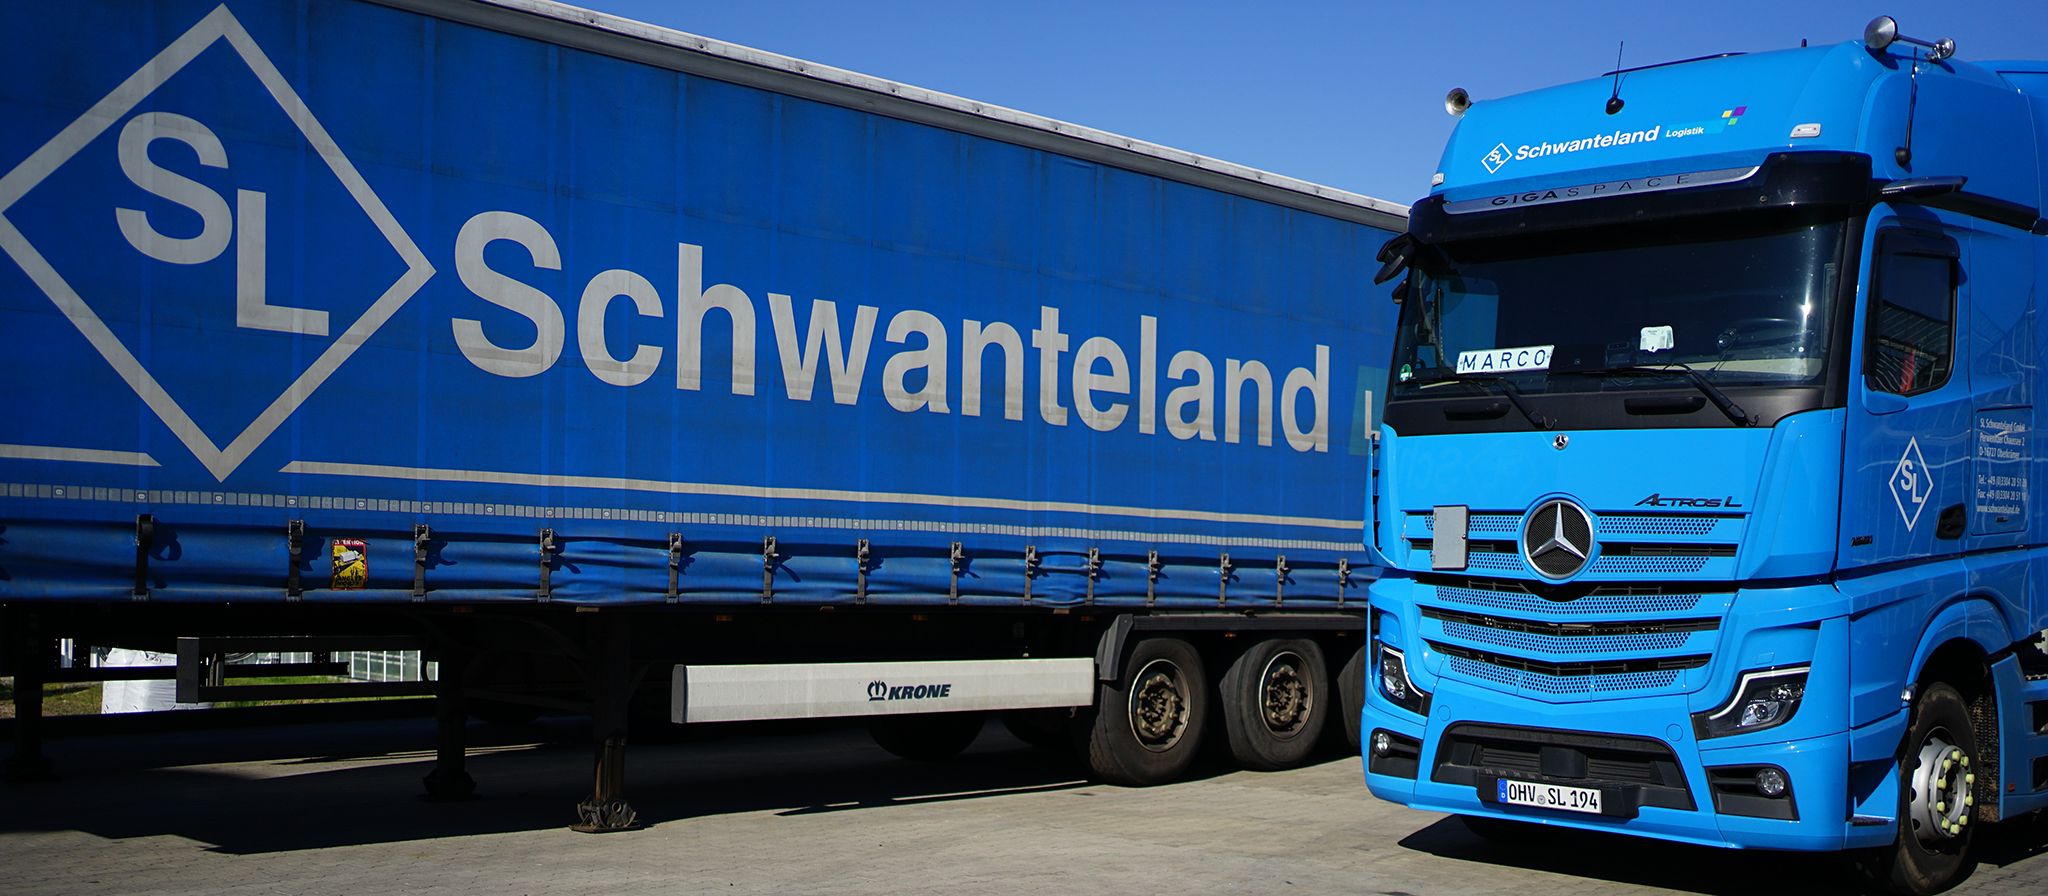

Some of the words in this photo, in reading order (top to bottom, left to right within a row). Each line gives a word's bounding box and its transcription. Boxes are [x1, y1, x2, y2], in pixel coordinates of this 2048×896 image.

[1515, 125, 1660, 161] Schwanteland
[1665, 126, 1704, 138] Logistik
[115, 111, 330, 336] SL
[451, 210, 1330, 453] Schwanteland
[1463, 350, 1546, 371] MARCO
[1986, 418, 2013, 431] Schwanteland
[2003, 435, 2021, 446] Chaussee
[1900, 459, 1923, 503] SL
[1724, 496, 1742, 507] L
[888, 684, 951, 700] KRONE
[1509, 783, 1536, 802] OHV
[1547, 787, 1566, 806] SL
[1570, 790, 1597, 809] 194
